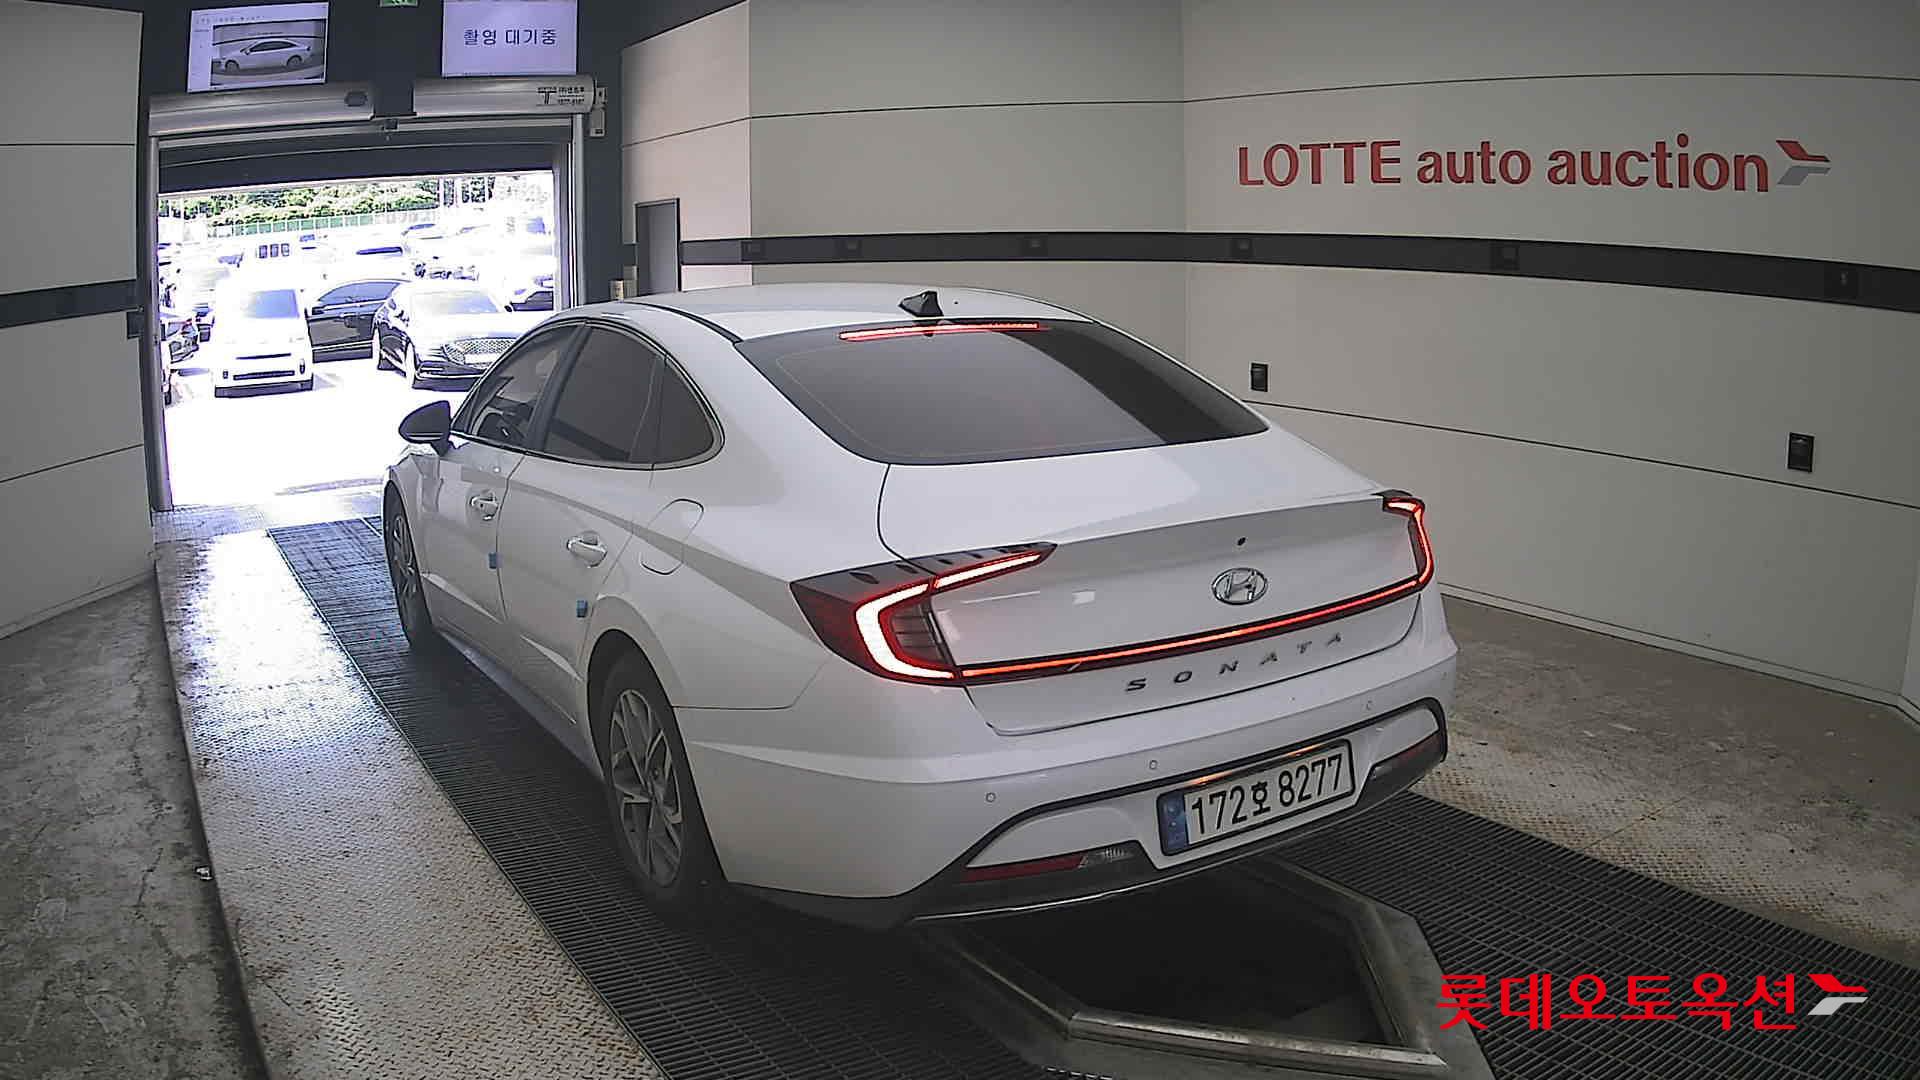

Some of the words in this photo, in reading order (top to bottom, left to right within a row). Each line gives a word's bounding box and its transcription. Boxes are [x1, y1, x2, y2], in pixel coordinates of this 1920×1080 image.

[463, 29, 497, 46] 촬영
[505, 29, 558, 46] 대기중
[1238, 140, 1401, 187] LOTTE
[1416, 140, 1532, 185] auto
[1547, 133, 1769, 192] auction
[1125, 632, 1342, 692] SONATA
[1191, 781, 1271, 834] 172호
[1278, 753, 1342, 807] 8277
